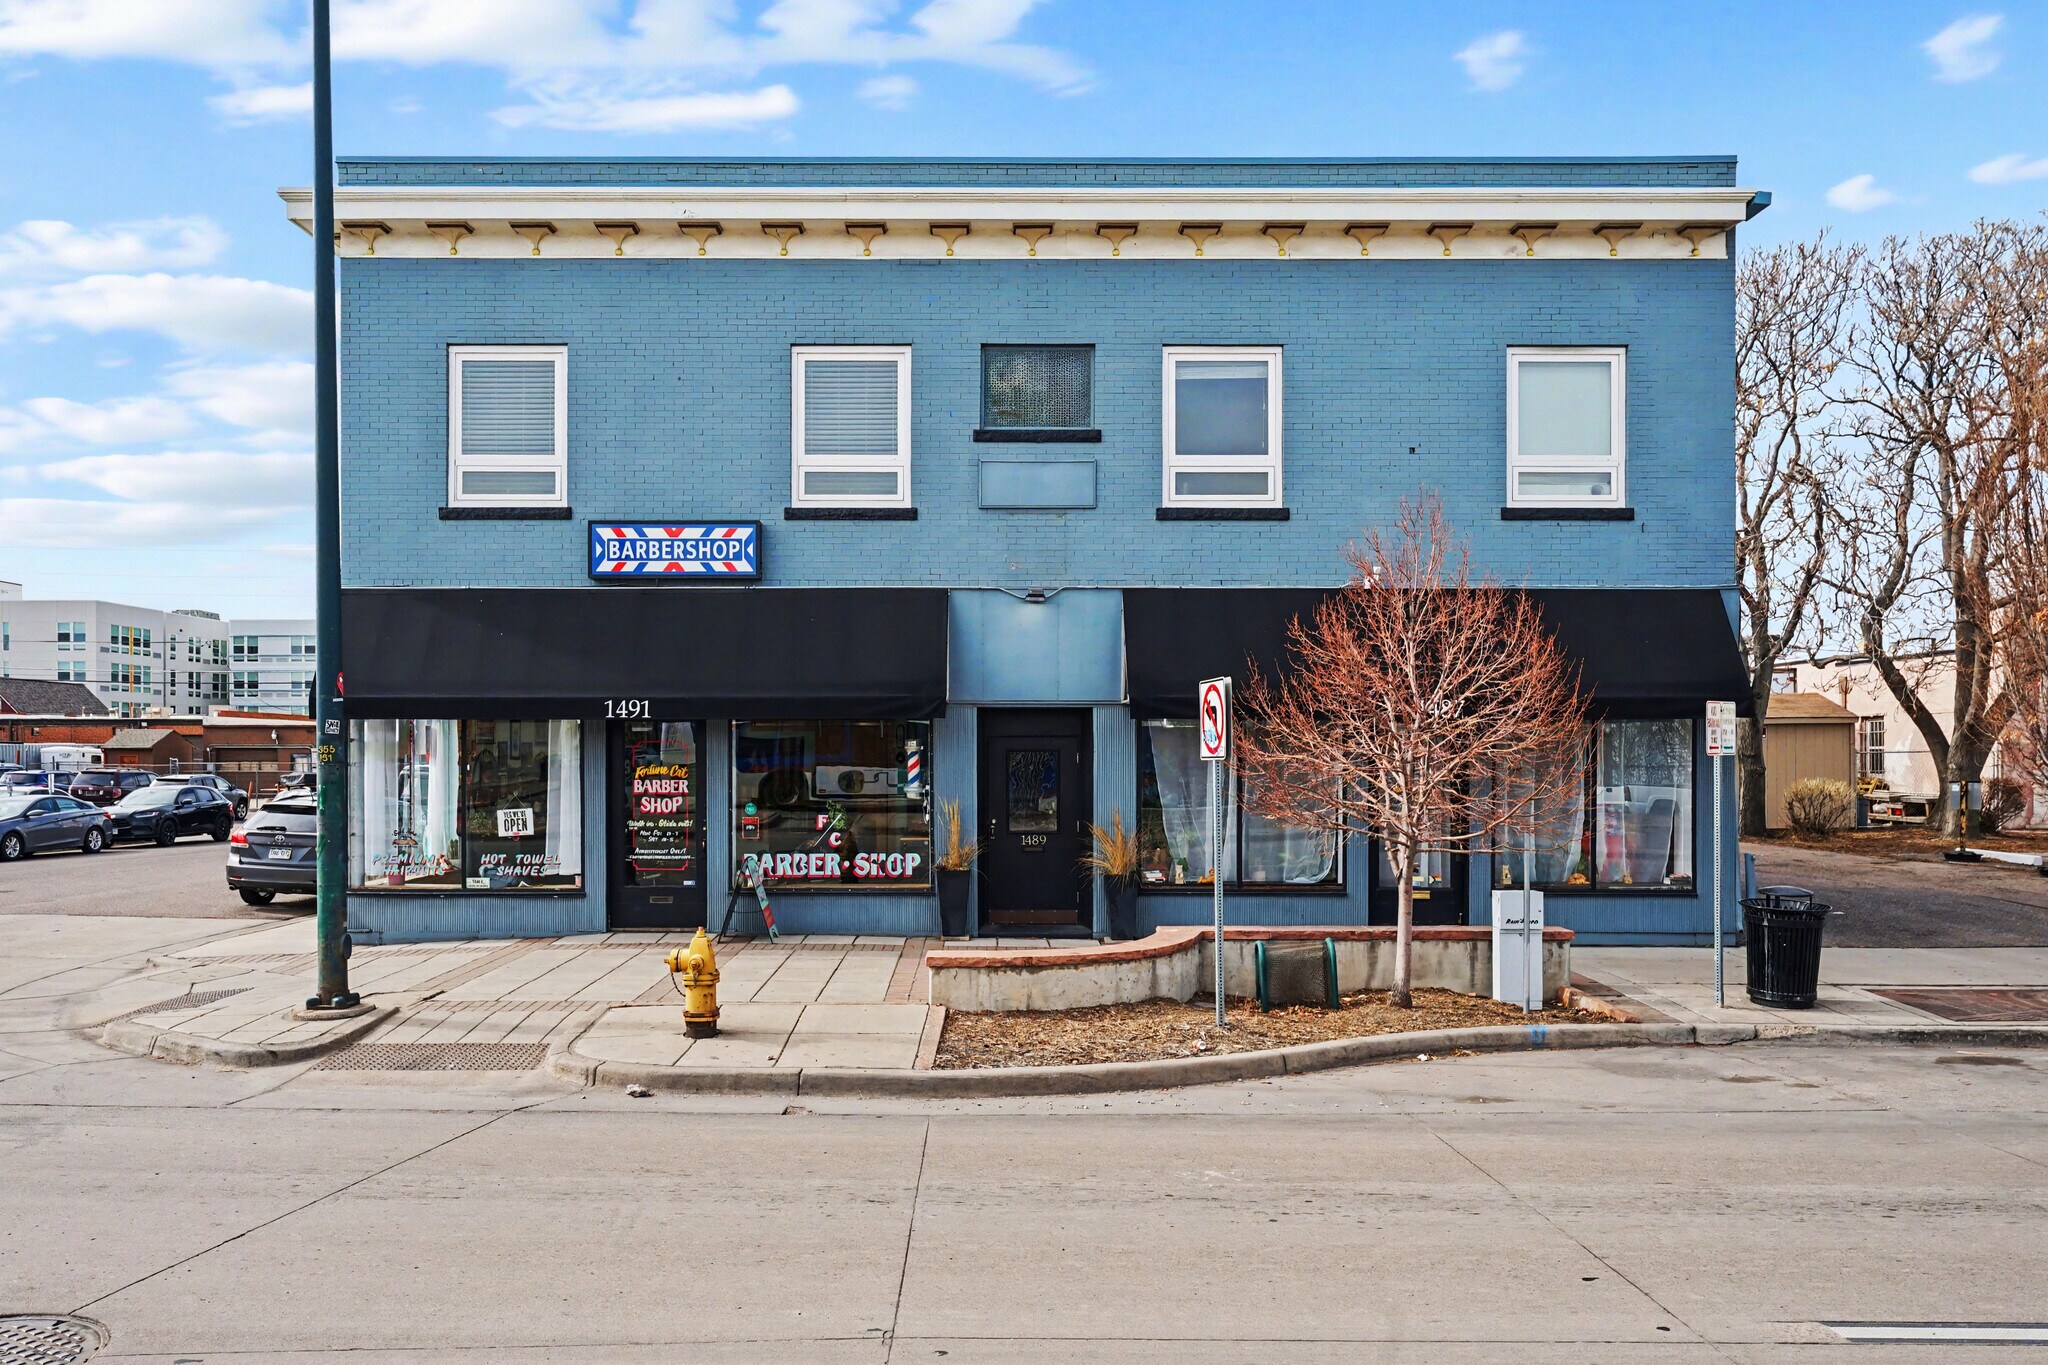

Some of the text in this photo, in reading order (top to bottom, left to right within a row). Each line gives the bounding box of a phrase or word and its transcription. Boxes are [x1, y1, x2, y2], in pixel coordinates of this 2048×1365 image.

[609, 540, 740, 560] BARBERSHOP
[604, 699, 652, 719] 1491
[634, 764, 689, 779] Fortune Cat
[632, 779, 689, 795] BARBER
[639, 796, 684, 815] SHOP
[503, 818, 528, 833] OPEN
[816, 814, 829, 830] F
[828, 832, 842, 848] C
[1020, 834, 1047, 846] 1489
[372, 852, 436, 866] PREMIUM
[480, 853, 562, 865] HOT TOWEL
[852, 853, 922, 878] SHOP
[383, 864, 445, 877] HAIRCUTS
[495, 865, 548, 877] SHAVES
